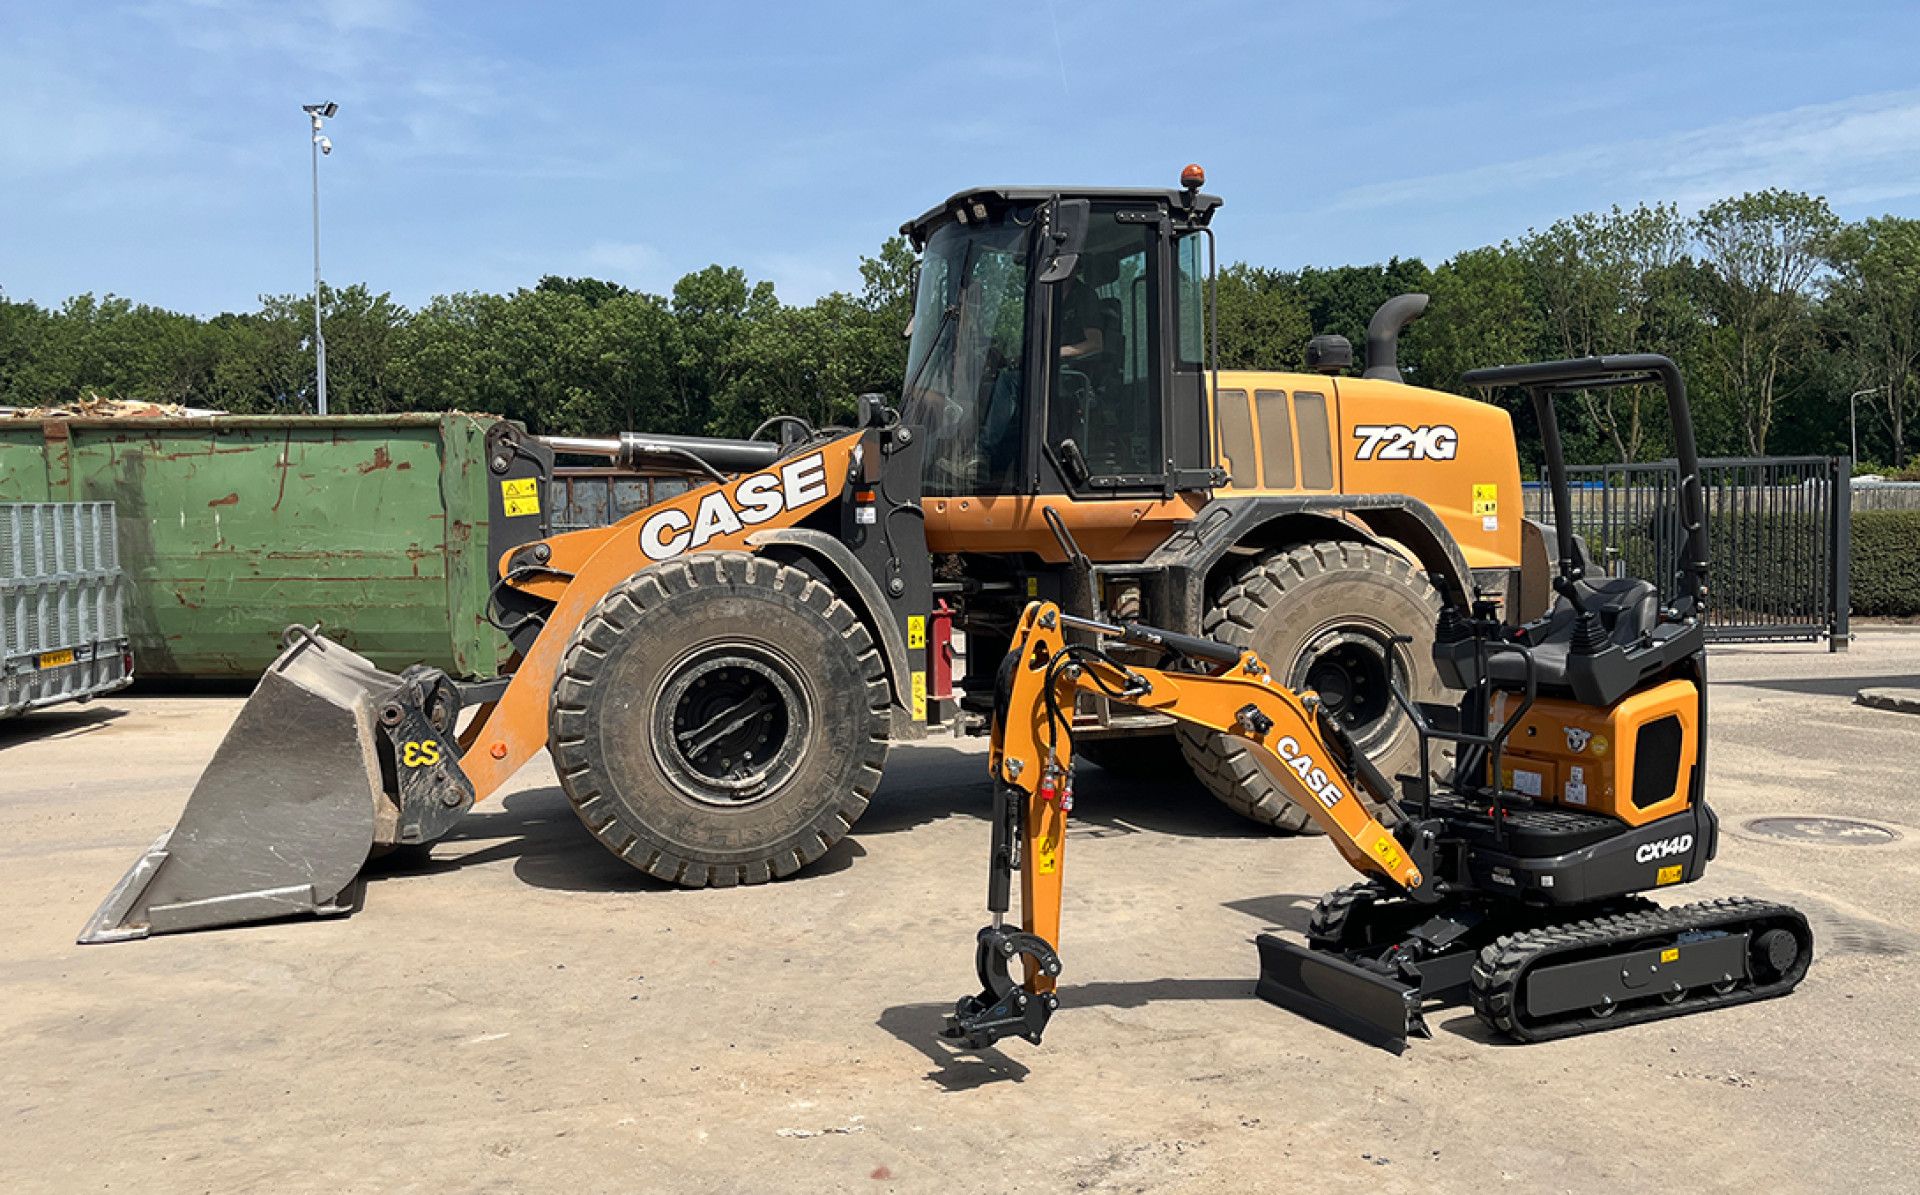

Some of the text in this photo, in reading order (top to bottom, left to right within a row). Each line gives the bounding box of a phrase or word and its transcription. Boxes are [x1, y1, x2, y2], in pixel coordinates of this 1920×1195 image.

[1354, 425, 1458, 460] 721G
[640, 451, 827, 560] CASE
[1277, 735, 1343, 808] CASE
[1635, 834, 1693, 863] CX14D
